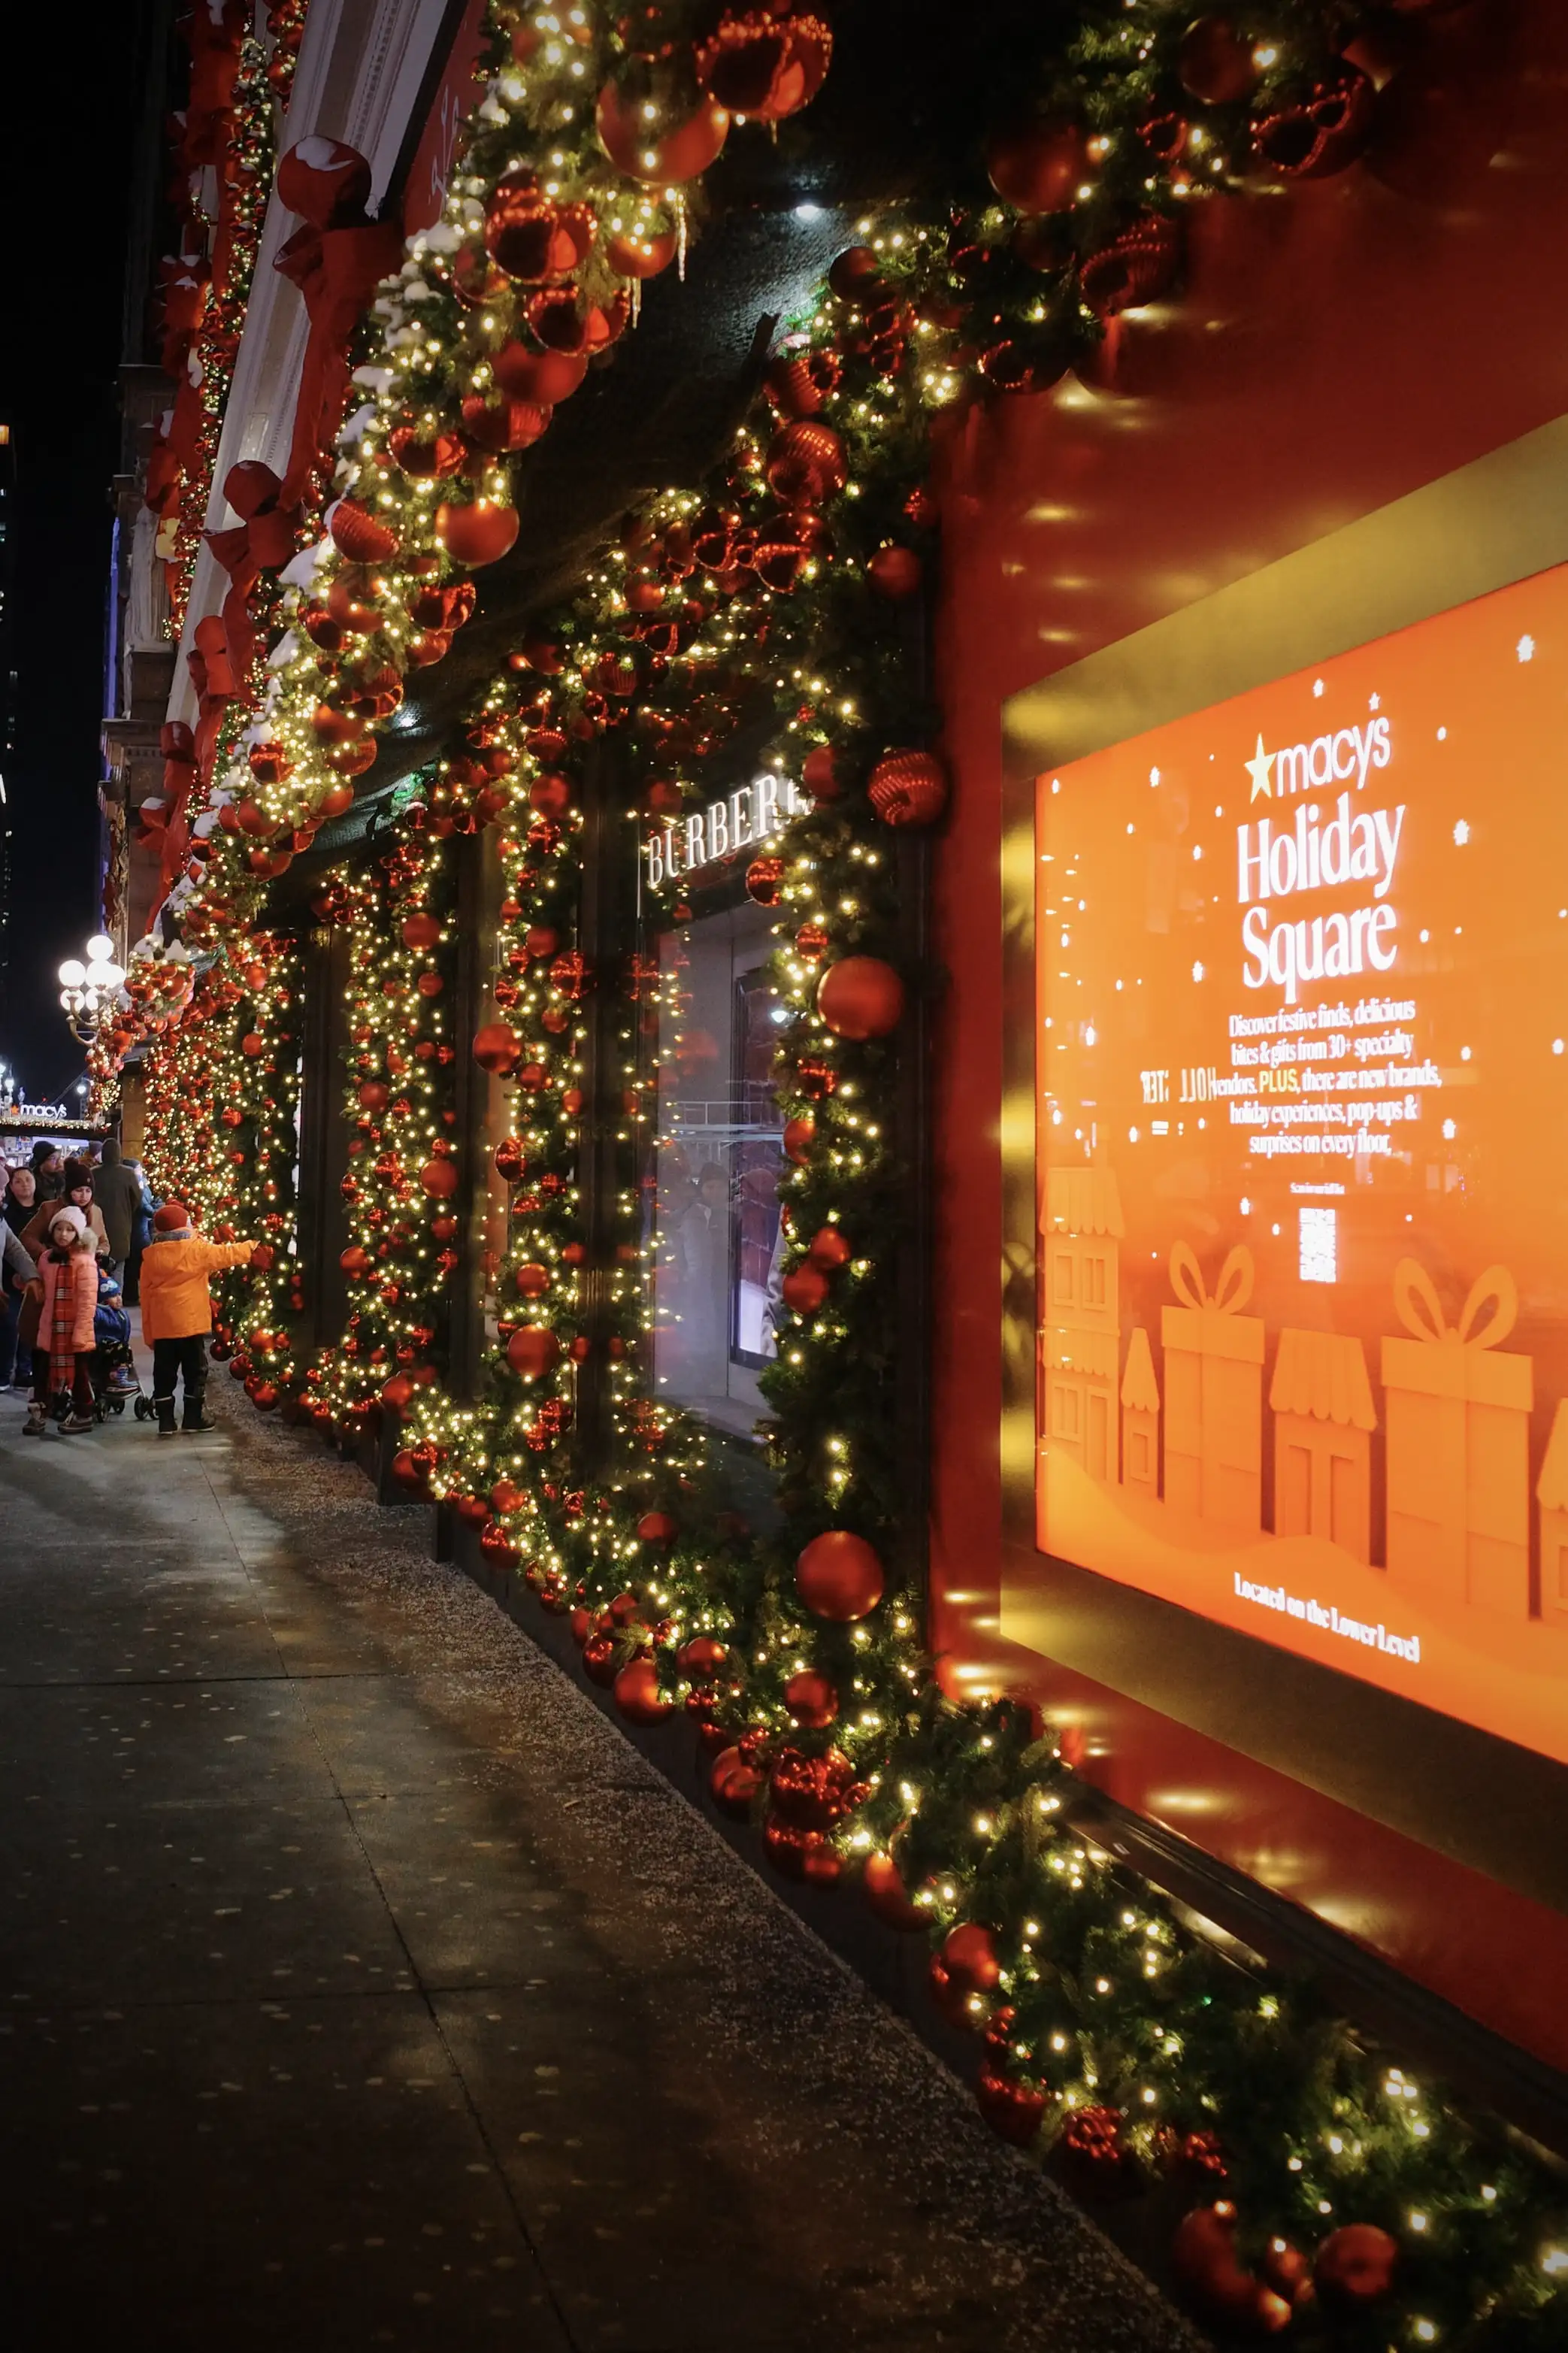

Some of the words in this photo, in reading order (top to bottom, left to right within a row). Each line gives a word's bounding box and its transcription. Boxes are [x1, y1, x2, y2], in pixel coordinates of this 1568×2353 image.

[1237, 792, 1406, 903] Holiday
[1243, 904, 1397, 1004] Square
[1229, 1014, 1277, 1037] Discover
[1277, 1007, 1318, 1033] festive
[1317, 1001, 1354, 1028] finds,
[1354, 997, 1416, 1025] delicious
[1230, 1042, 1259, 1065] bites
[1259, 1040, 1271, 1064] &
[1270, 1037, 1297, 1068] gifts
[1297, 1036, 1327, 1061] from
[1327, 1033, 1353, 1059] 30+
[1354, 1027, 1415, 1063] specialty
[1258, 1068, 1301, 1095] PLUS,
[1301, 1067, 1336, 1092] there
[1336, 1071, 1358, 1089] are
[1358, 1068, 1389, 1089] new
[1388, 1058, 1442, 1088] brands,
[1230, 1100, 1270, 1129] holiday
[1270, 1098, 1346, 1128] experiences,
[1346, 1101, 1403, 1127] pop-ups
[1403, 1094, 1418, 1120] &
[1249, 1130, 1303, 1159] surprises
[1303, 1135, 1321, 1153] on
[1321, 1134, 1357, 1158] every
[1234, 1571, 1286, 1612] Located
[1286, 1596, 1306, 1619] on
[1306, 1599, 1330, 1628] the
[1330, 1607, 1377, 1646] Lower
[1377, 1624, 1421, 1664] Level
